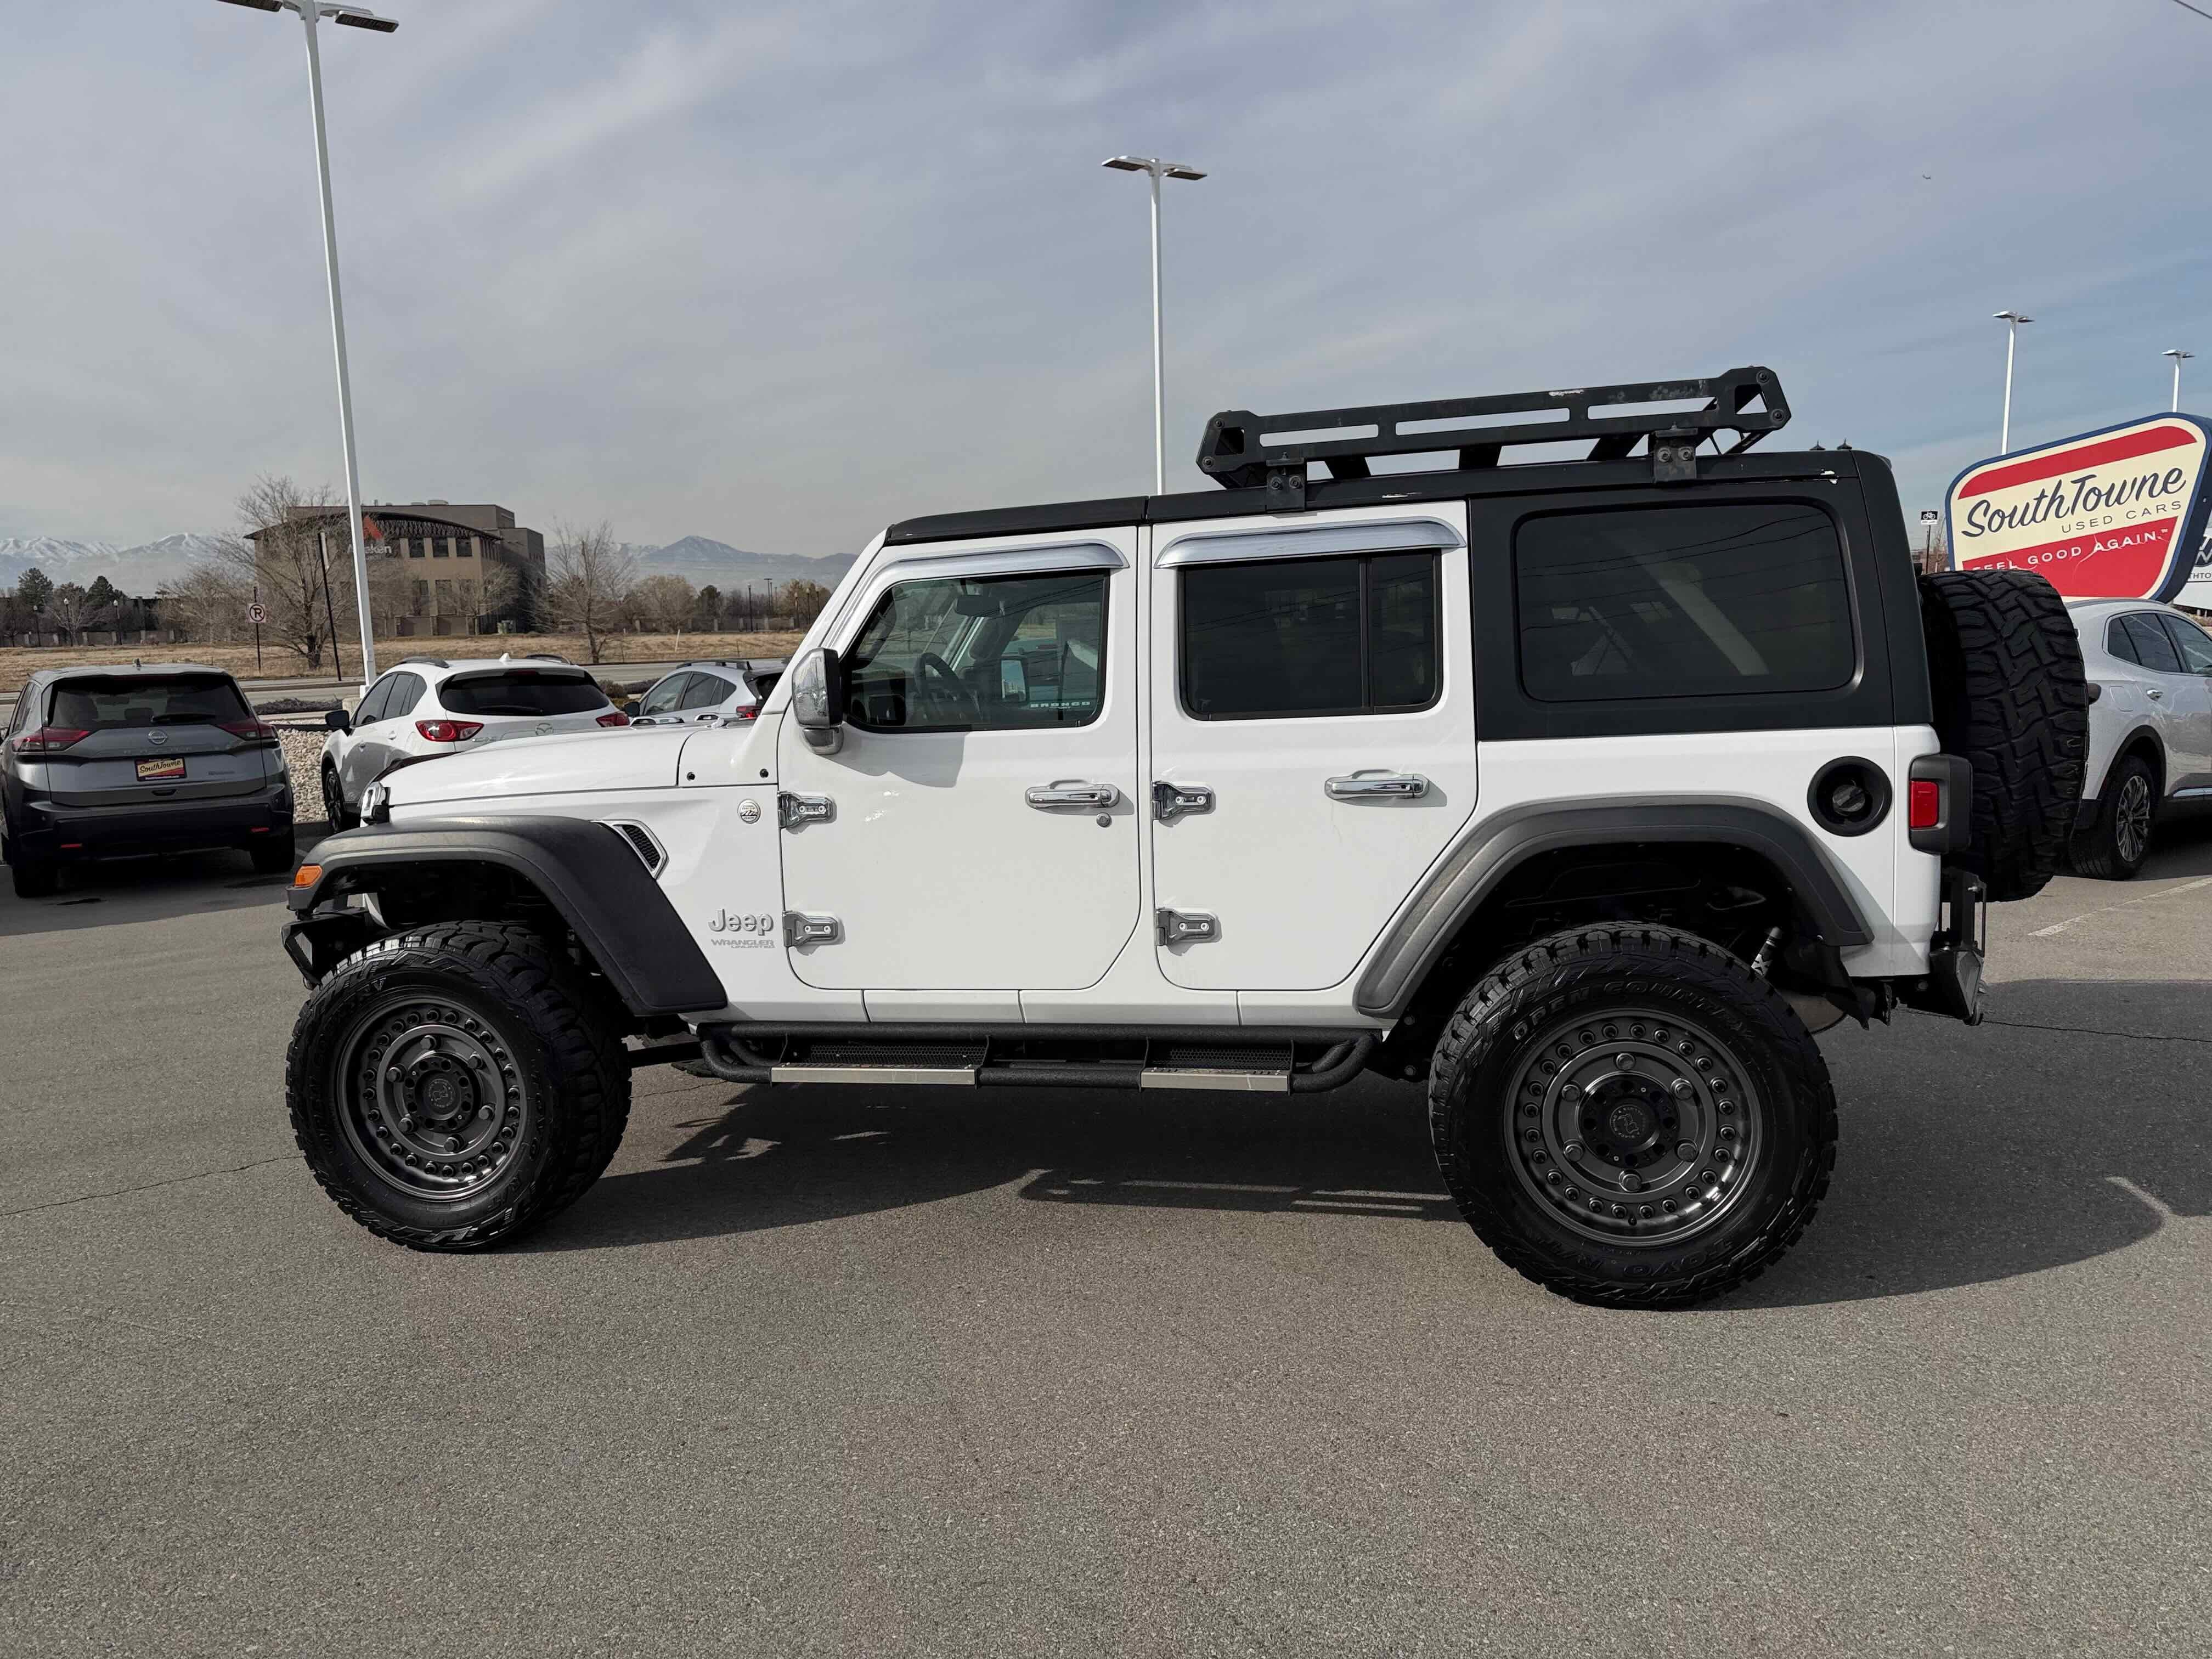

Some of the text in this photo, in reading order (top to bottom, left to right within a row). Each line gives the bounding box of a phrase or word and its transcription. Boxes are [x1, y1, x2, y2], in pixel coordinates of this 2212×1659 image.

[1961, 467, 2186, 537] SouthTowne
[2062, 500, 2182, 533] USED CARS
[2028, 546, 2081, 565] GOOD
[708, 909, 774, 936] Jeep
